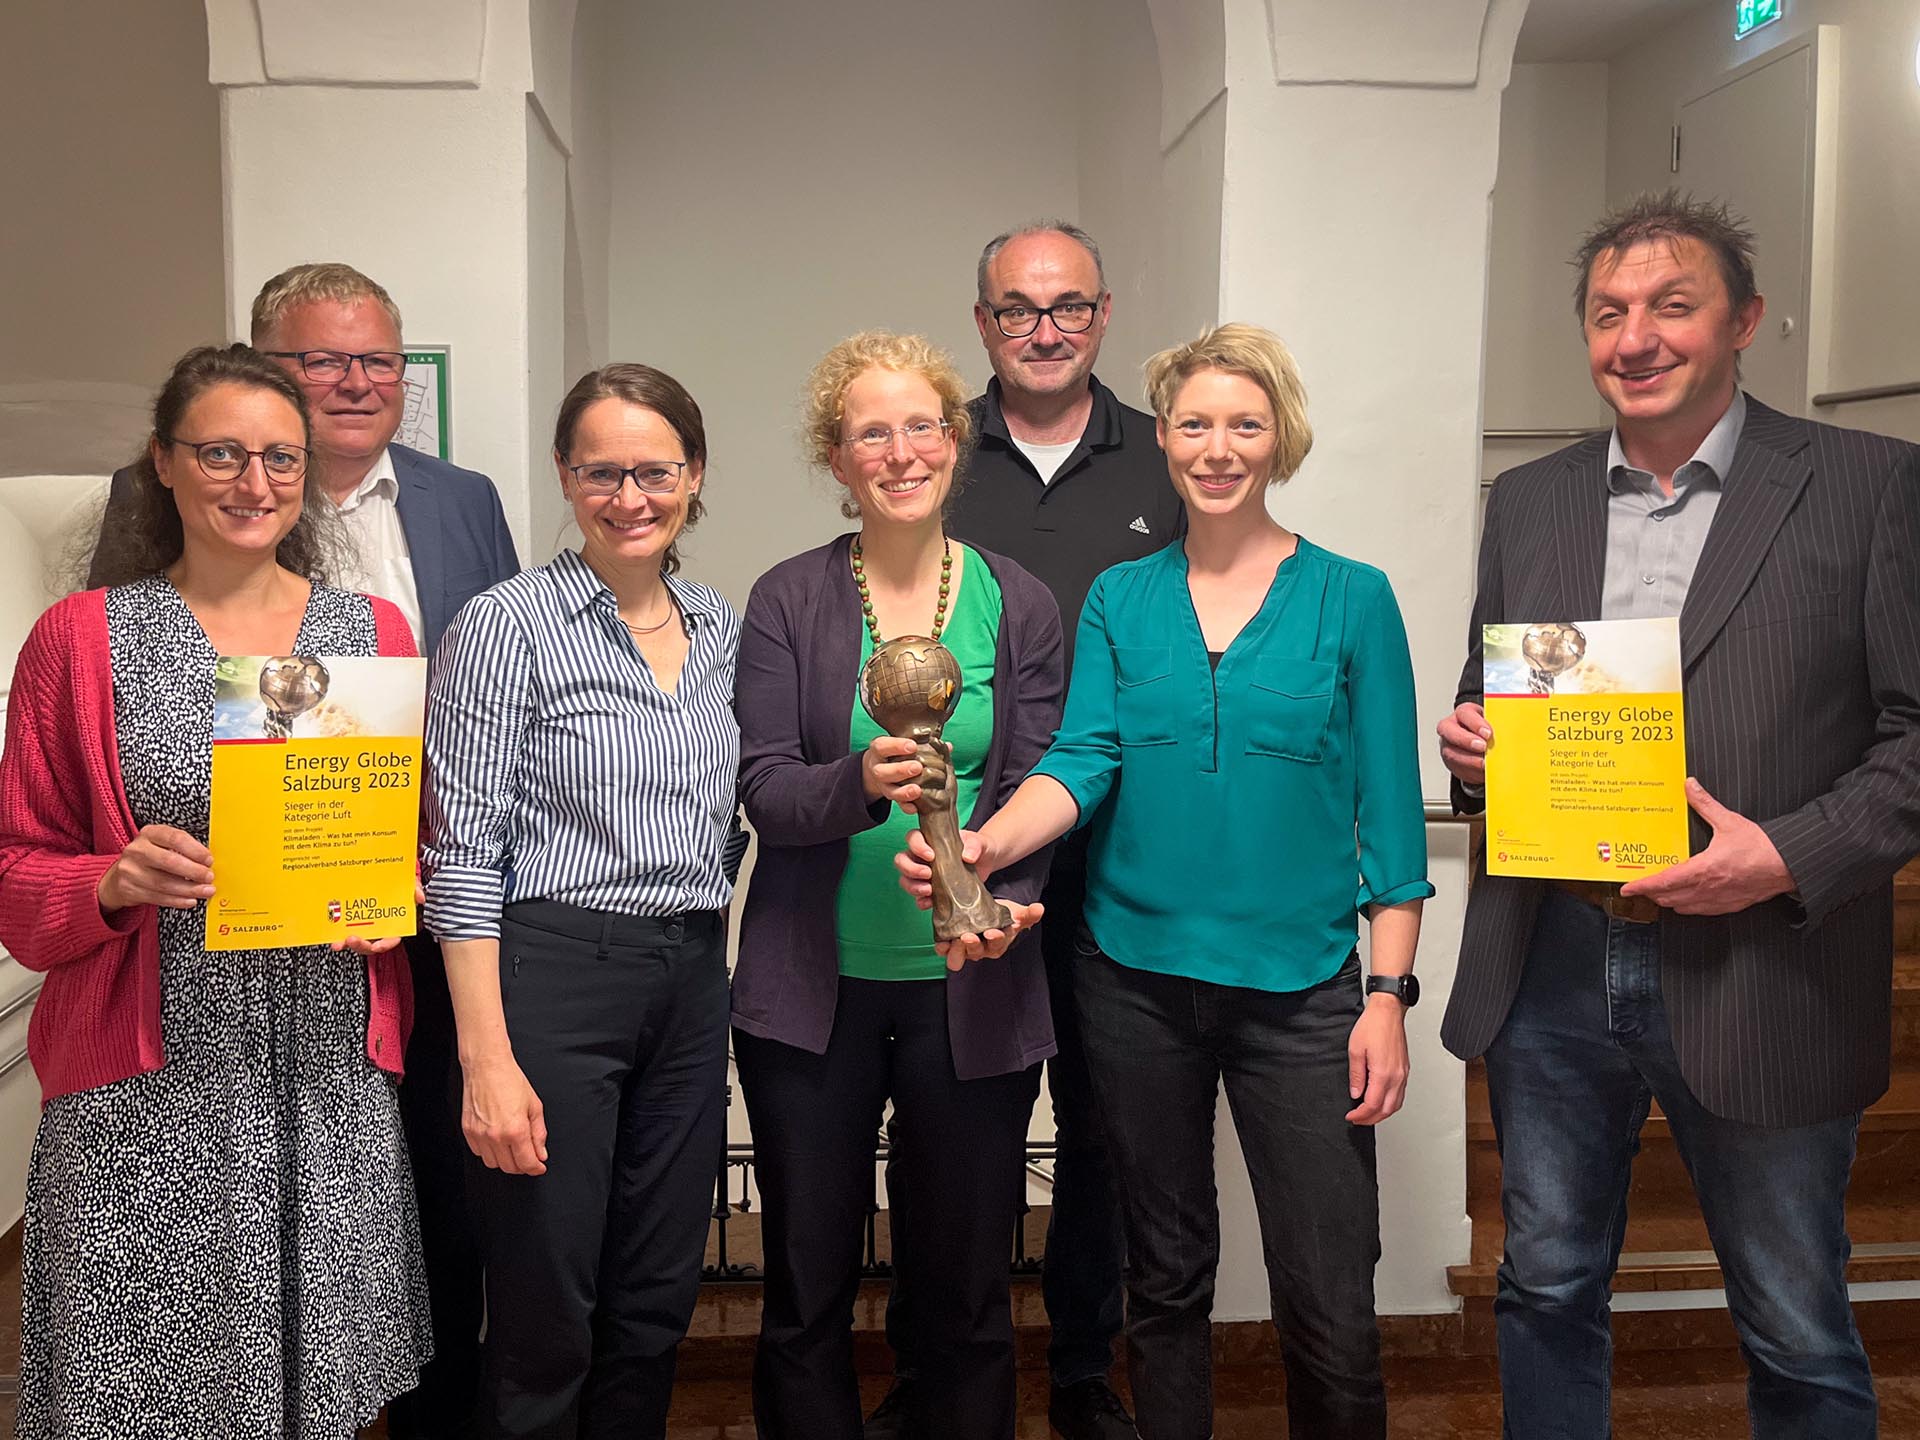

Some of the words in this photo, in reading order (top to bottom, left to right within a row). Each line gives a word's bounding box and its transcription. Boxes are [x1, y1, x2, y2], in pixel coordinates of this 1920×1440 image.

[1549, 707, 1611, 725] Energy
[1618, 707, 1674, 722] Globe
[1547, 726, 1624, 744] Salzburg
[1631, 726, 1674, 742] 2023
[1550, 749, 1578, 760] Sieger
[1581, 750, 1590, 758] in
[1593, 750, 1609, 759] der
[285, 753, 350, 773] Energy
[357, 751, 412, 769] Globe
[1550, 759, 1594, 769] Kategorie
[1597, 759, 1616, 768] Luft
[282, 774, 361, 793] Salzburg
[368, 771, 411, 789] 2023
[284, 801, 314, 812] Sieger
[317, 801, 326, 810] in
[329, 800, 345, 809] der
[284, 812, 330, 823] Kategorie
[333, 810, 352, 820] Luft
[296, 842, 311, 850] dem
[1614, 843, 1648, 854] LAND
[339, 858, 373, 867] Salzburger
[1510, 854, 1549, 862] SALZBURG
[1614, 853, 1680, 866] SALZBURG
[345, 897, 378, 911] LAND
[345, 906, 407, 922] SALZBURG
[232, 924, 277, 933] SALZBURG
